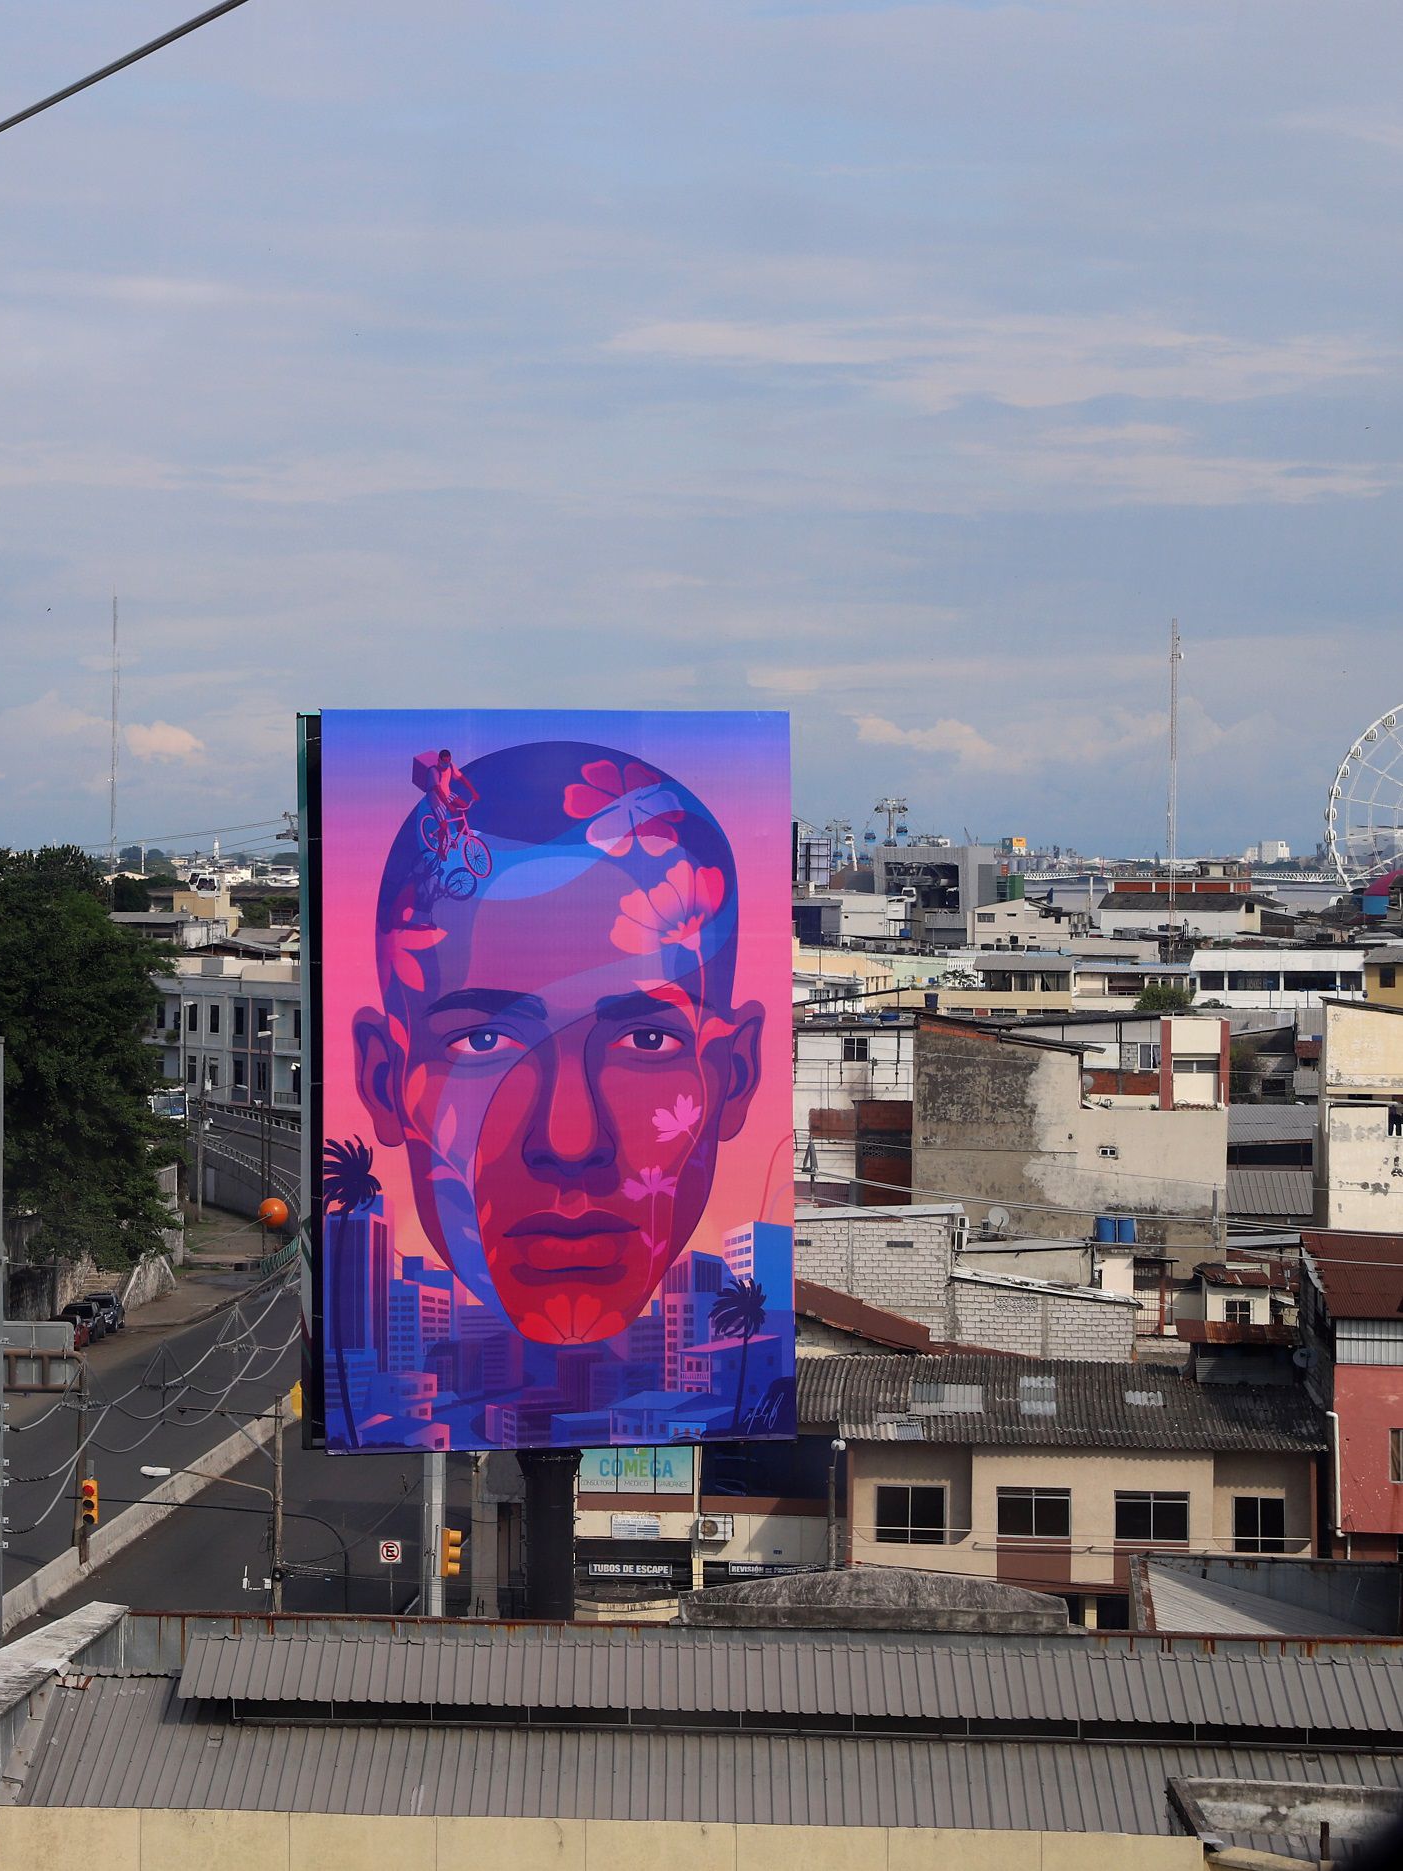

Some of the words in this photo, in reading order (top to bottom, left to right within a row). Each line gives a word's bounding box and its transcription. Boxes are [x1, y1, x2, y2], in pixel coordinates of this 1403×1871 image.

[599, 1458, 674, 1478] COMEGA
[386, 1546, 395, 1557] E
[593, 1564, 621, 1573] TUBOS
[622, 1564, 634, 1573] DE
[636, 1564, 669, 1574] ESCAPE
